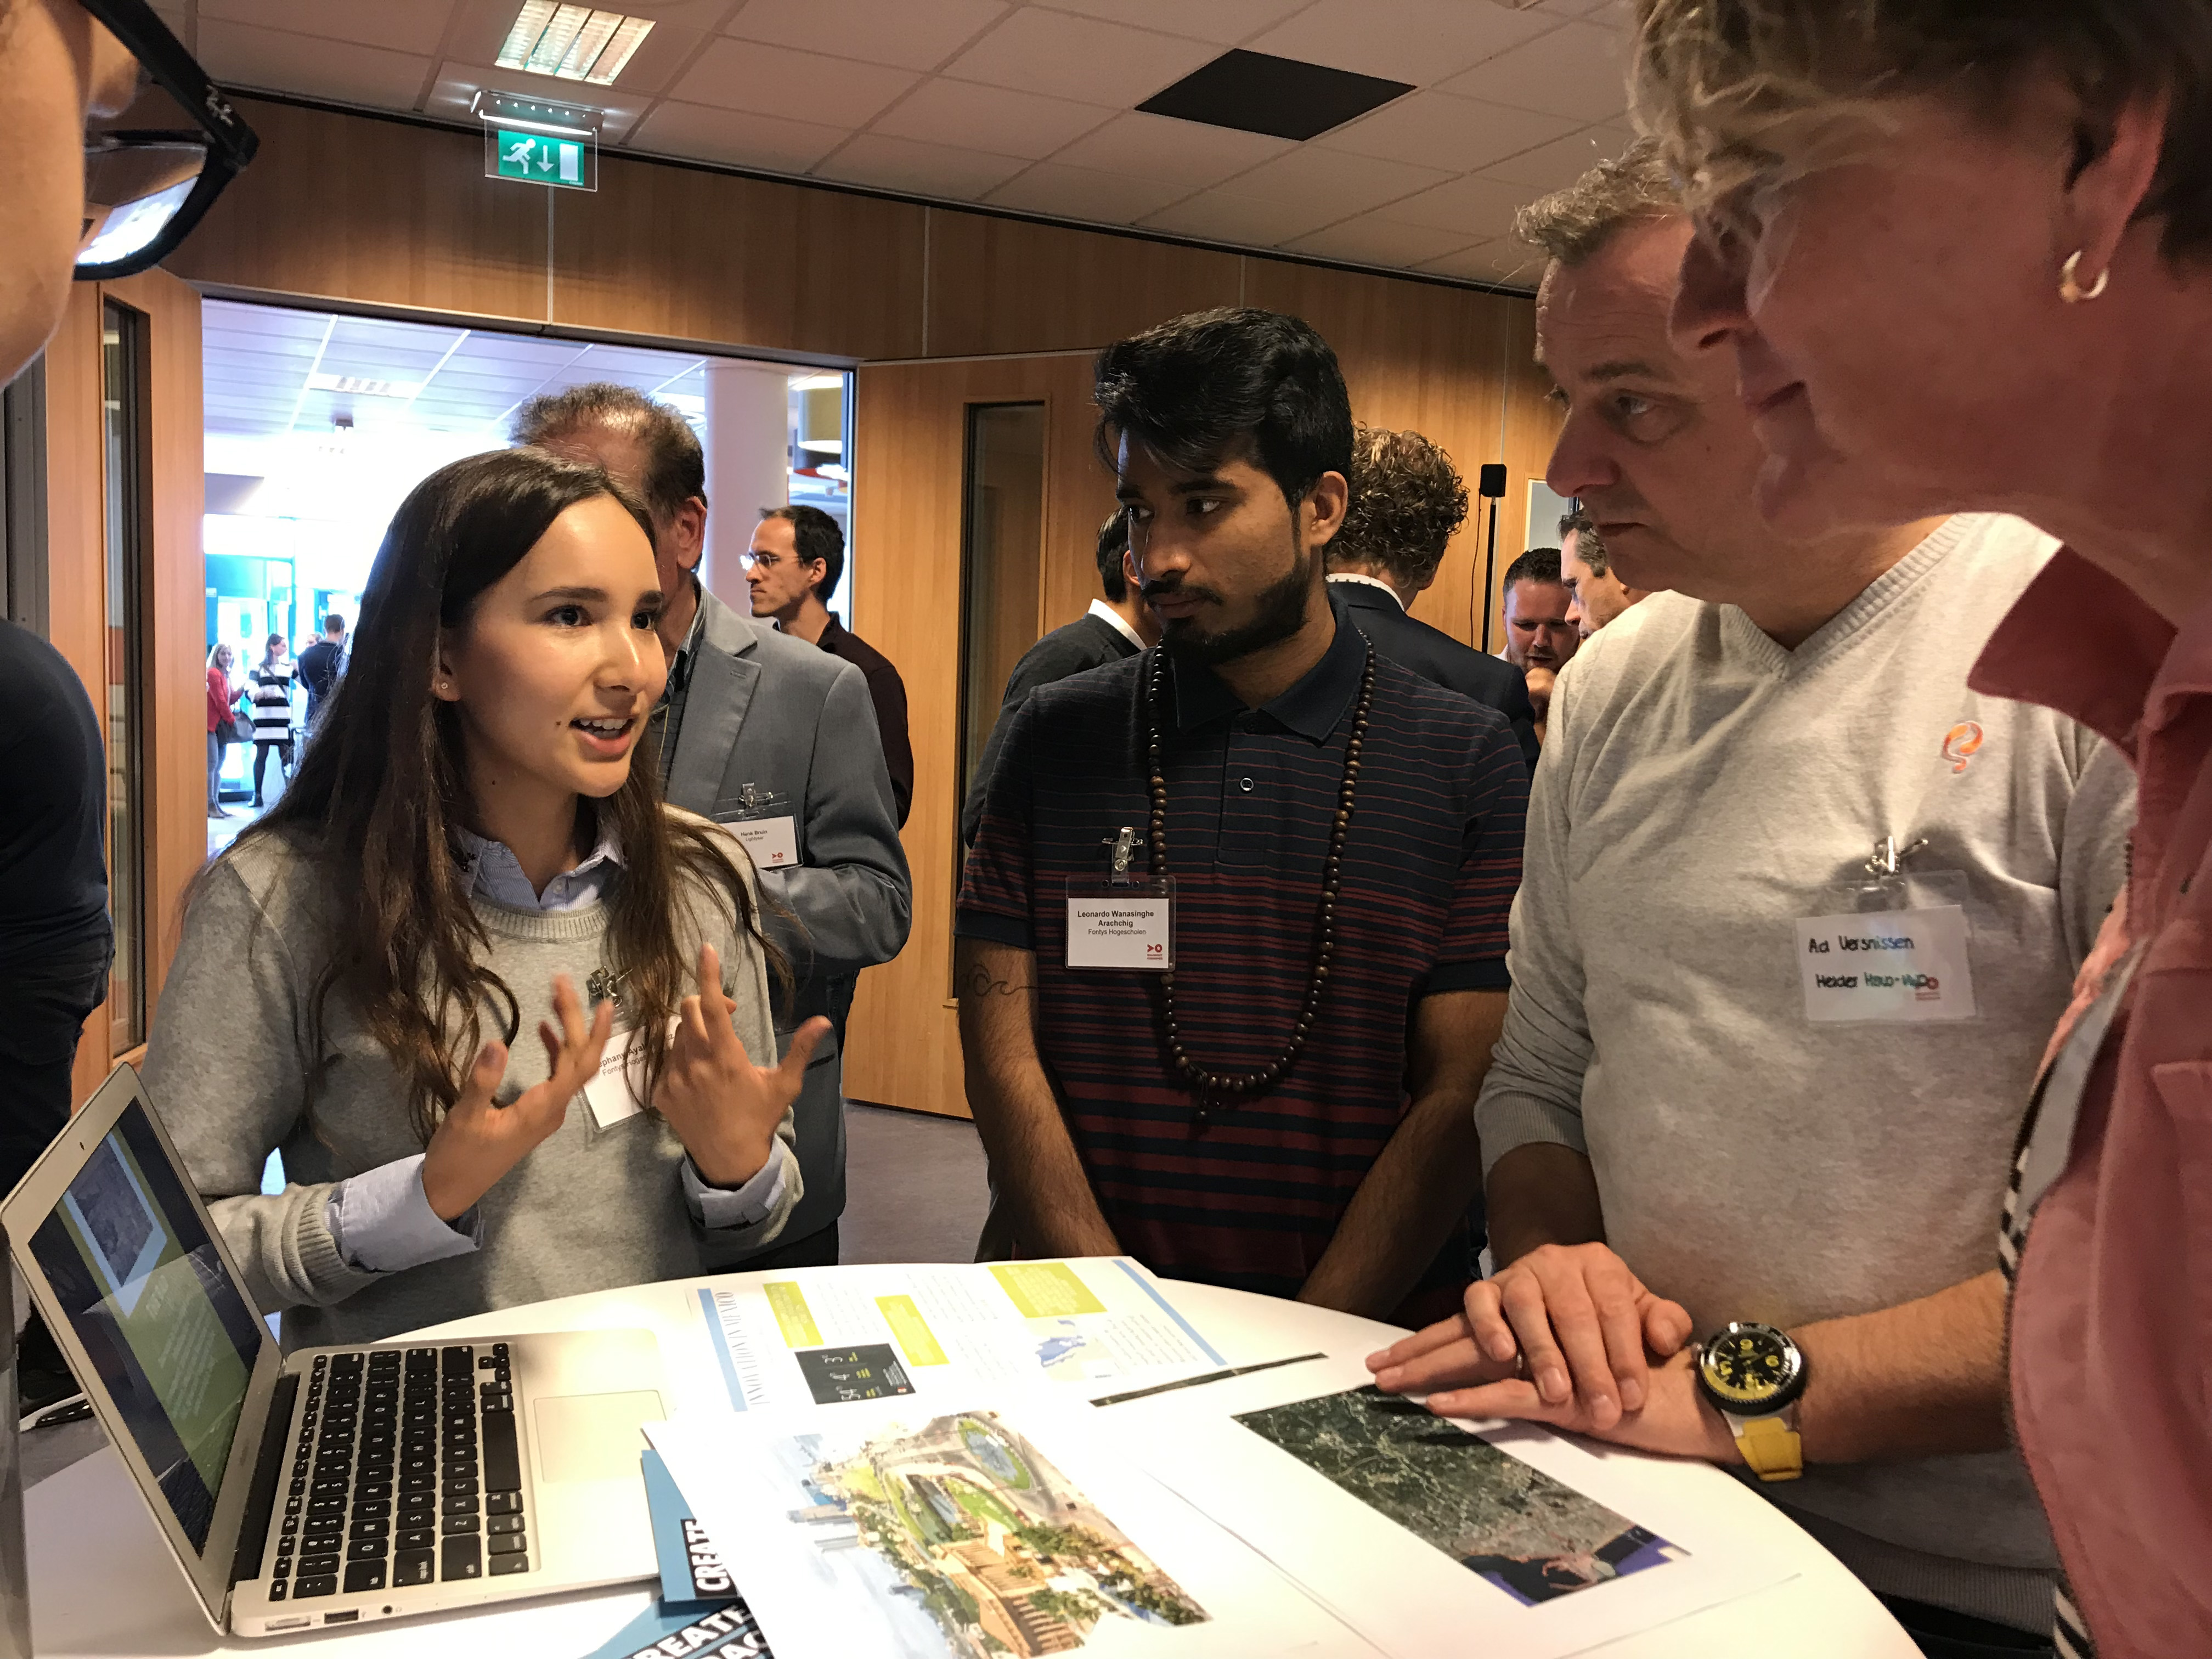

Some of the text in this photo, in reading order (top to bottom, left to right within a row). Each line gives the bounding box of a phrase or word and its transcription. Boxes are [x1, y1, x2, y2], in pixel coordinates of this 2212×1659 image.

[1111, 910, 1154, 918] Wanasinghe
[1098, 919, 1133, 928] Arachchig
[1809, 938, 1830, 953] Ad
